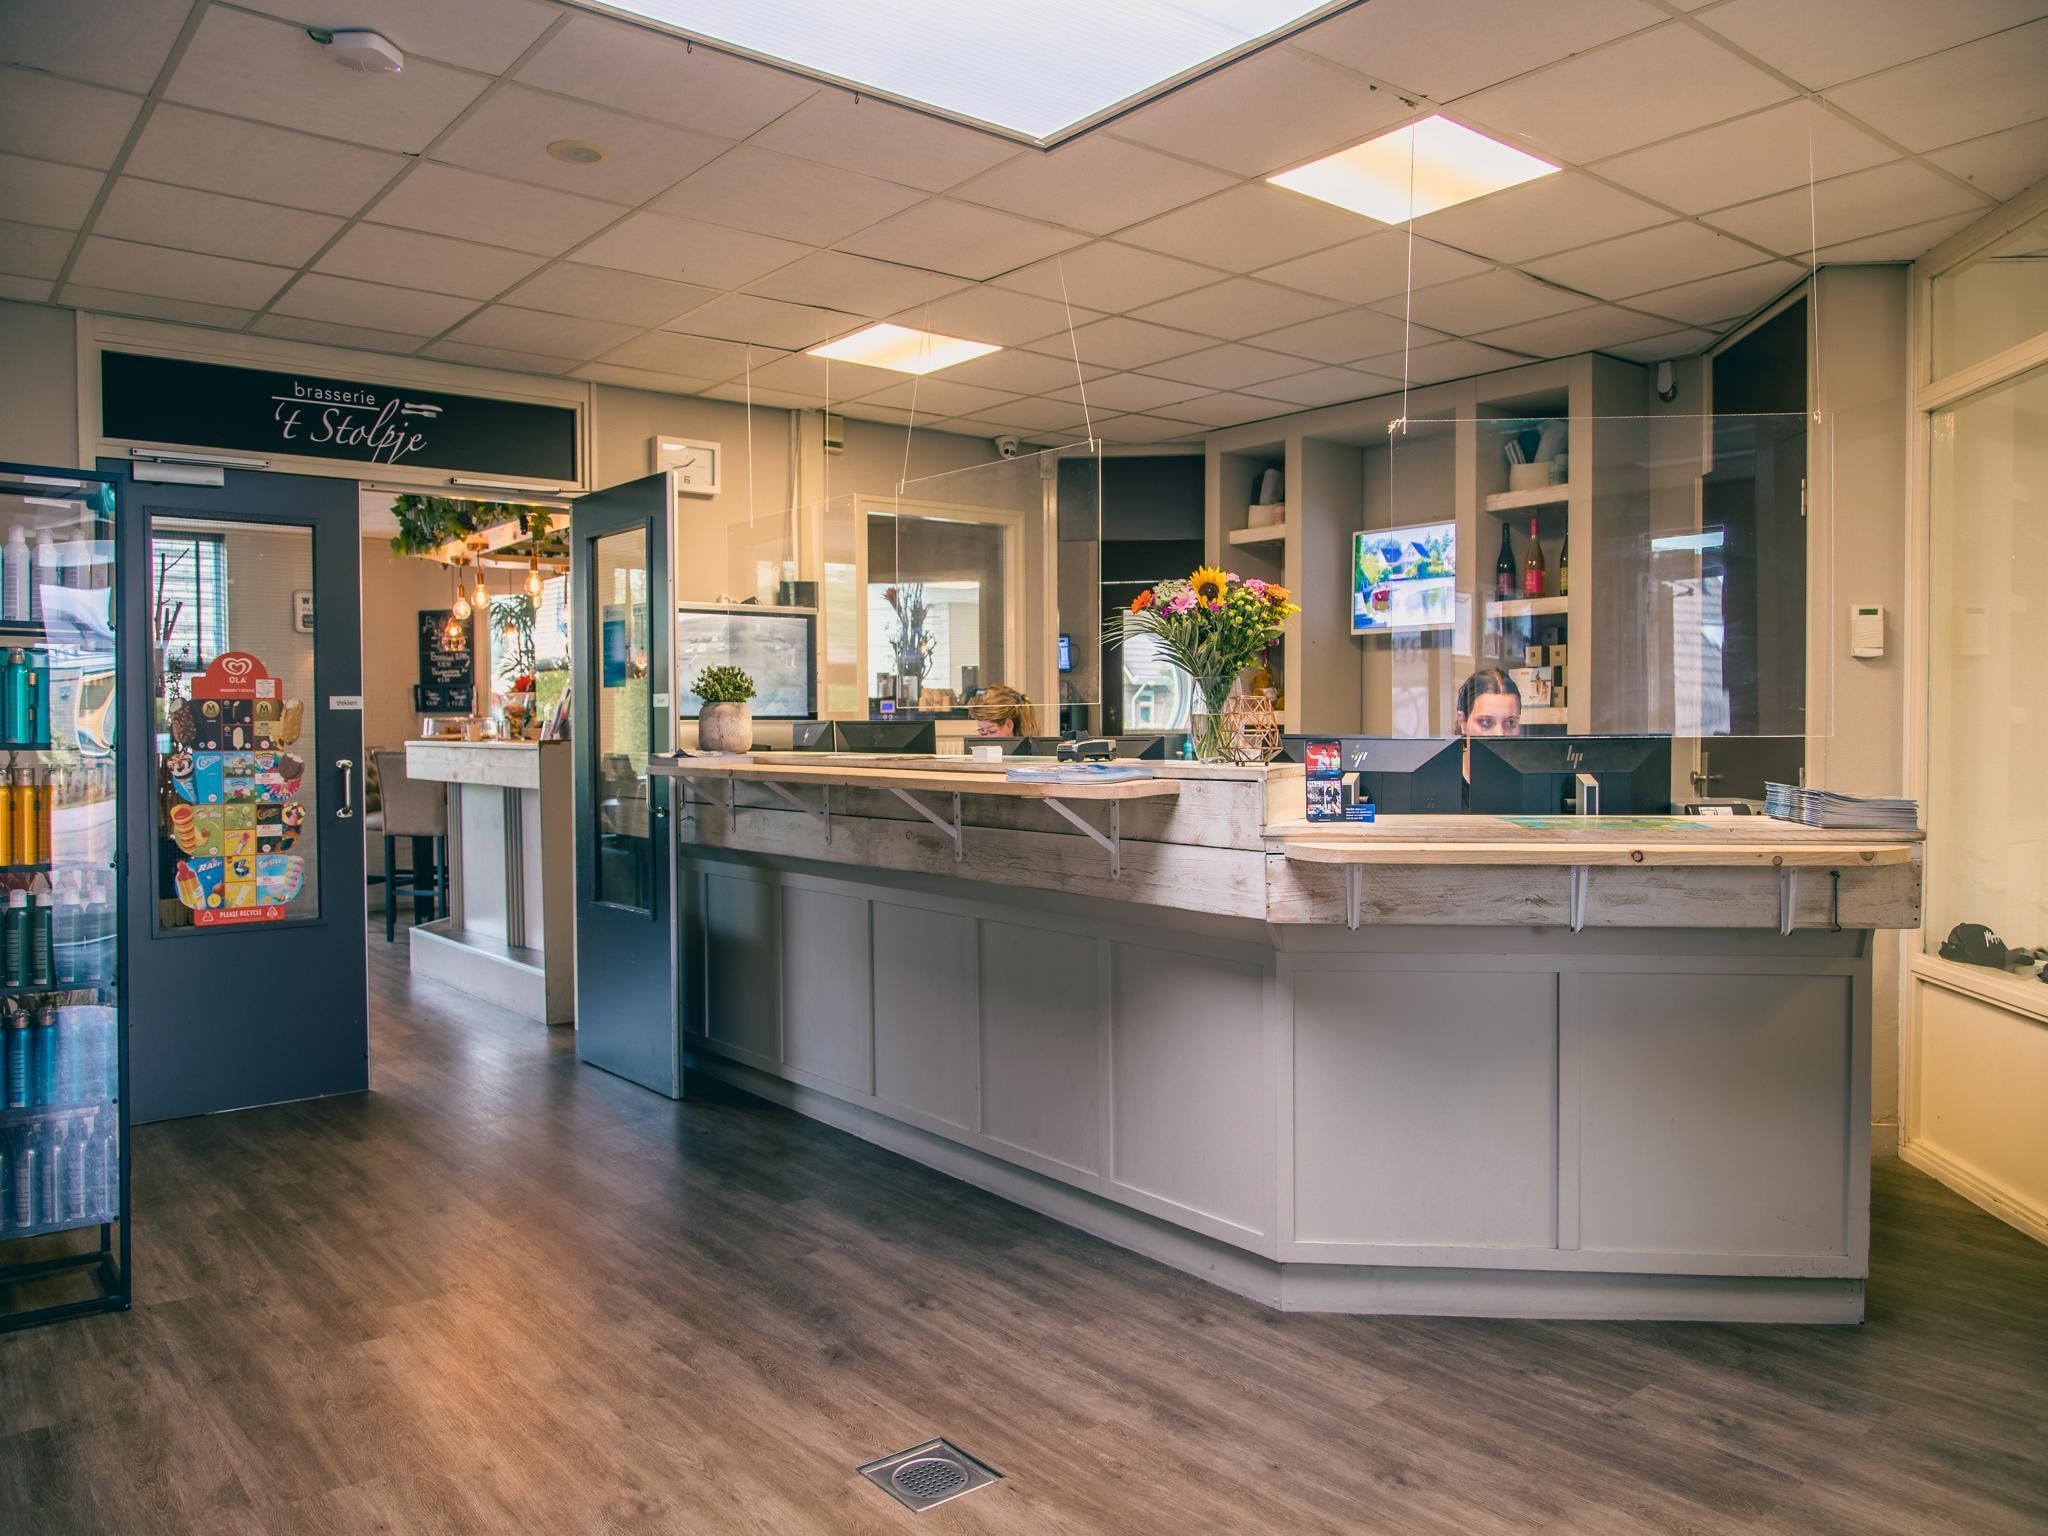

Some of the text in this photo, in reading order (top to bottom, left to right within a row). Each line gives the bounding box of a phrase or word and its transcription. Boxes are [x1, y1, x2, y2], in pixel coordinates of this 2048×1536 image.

[294, 380, 376, 405] brasserie
[310, 398, 428, 465] Stolpje
[228, 676, 247, 684] OLA
[1566, 744, 1584, 769] hp
[219, 910, 239, 919] PLEASE
